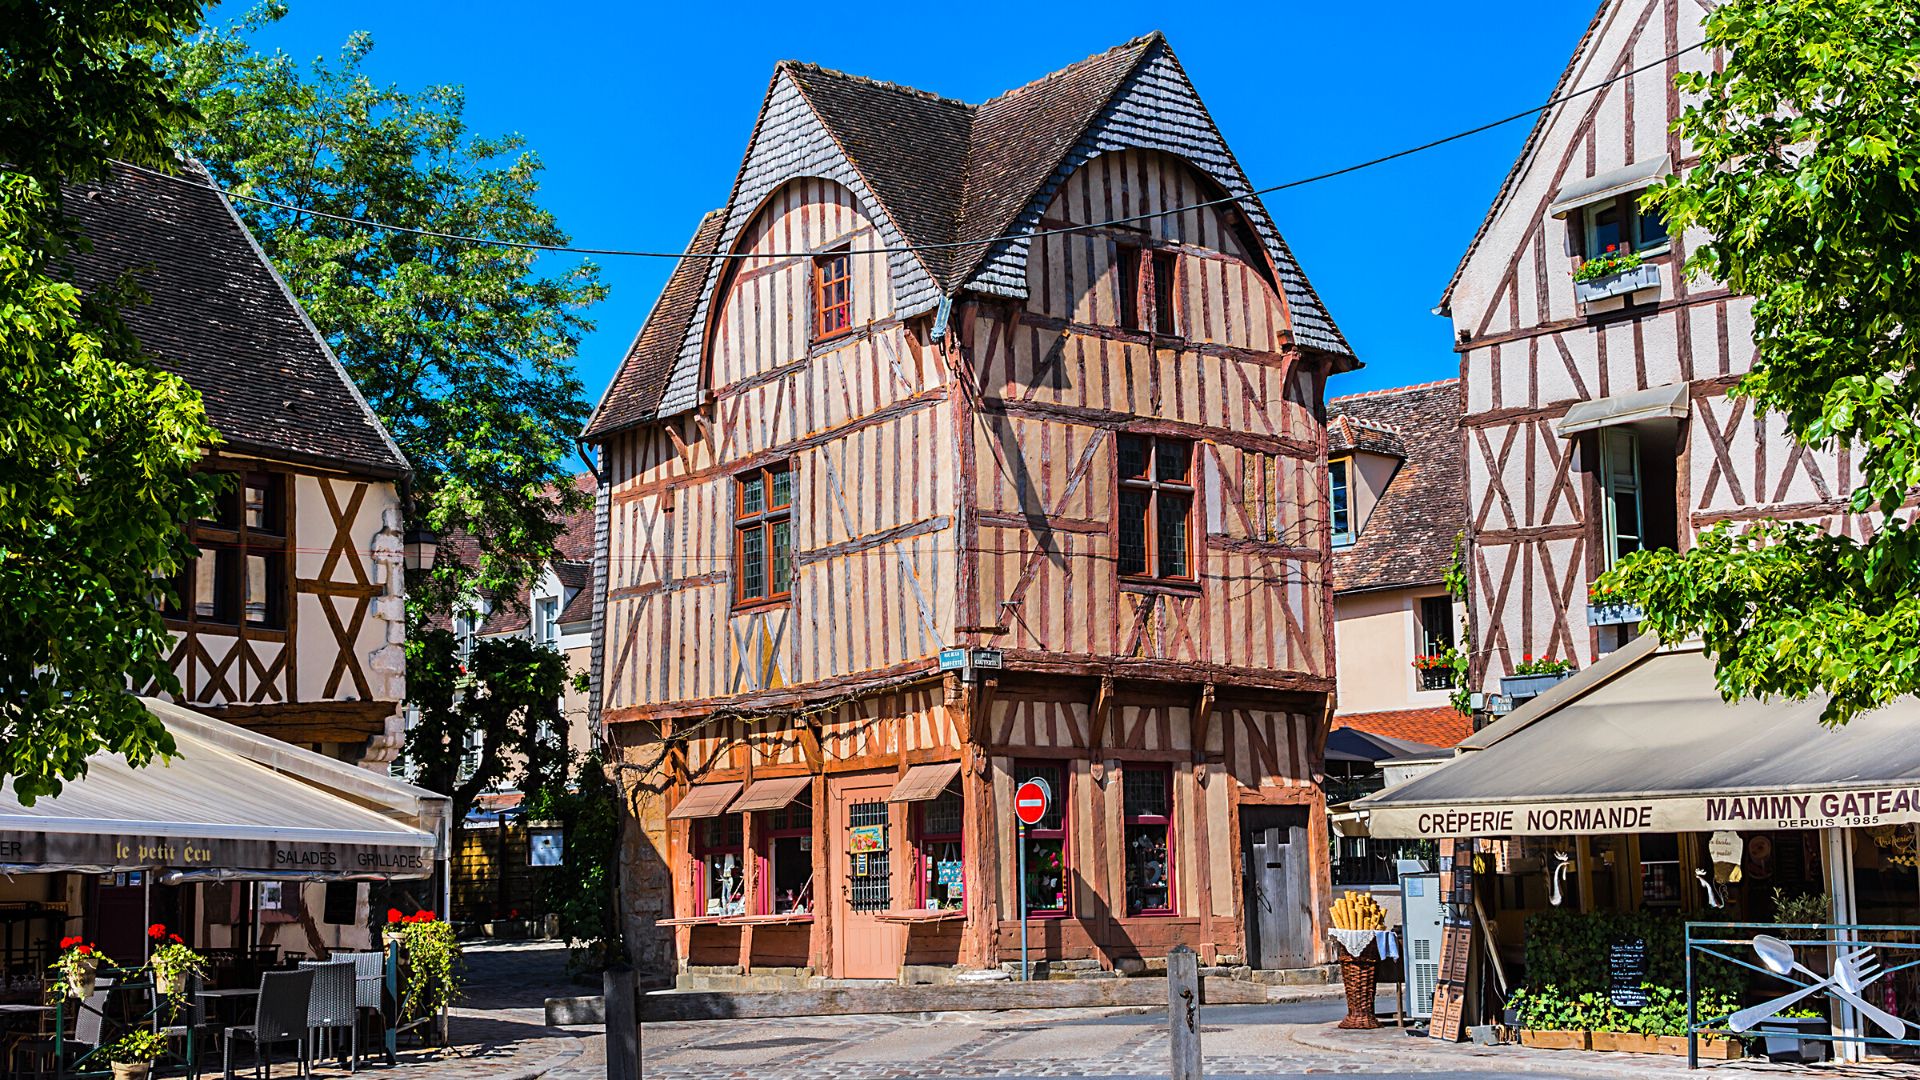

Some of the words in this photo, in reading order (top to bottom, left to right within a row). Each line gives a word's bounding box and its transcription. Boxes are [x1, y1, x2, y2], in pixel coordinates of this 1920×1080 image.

[1418, 809, 1513, 833] CRÊPERIE
[1527, 806, 1652, 830] NORMANDE
[1706, 795, 1810, 821] MAMMY
[1778, 818, 1835, 828] DEPUIS
[1844, 816, 1879, 826] 1985
[116, 841, 130, 859] le
[138, 843, 175, 864] petit
[276, 850, 337, 865] SALADES
[357, 853, 423, 868] GRILLADES
